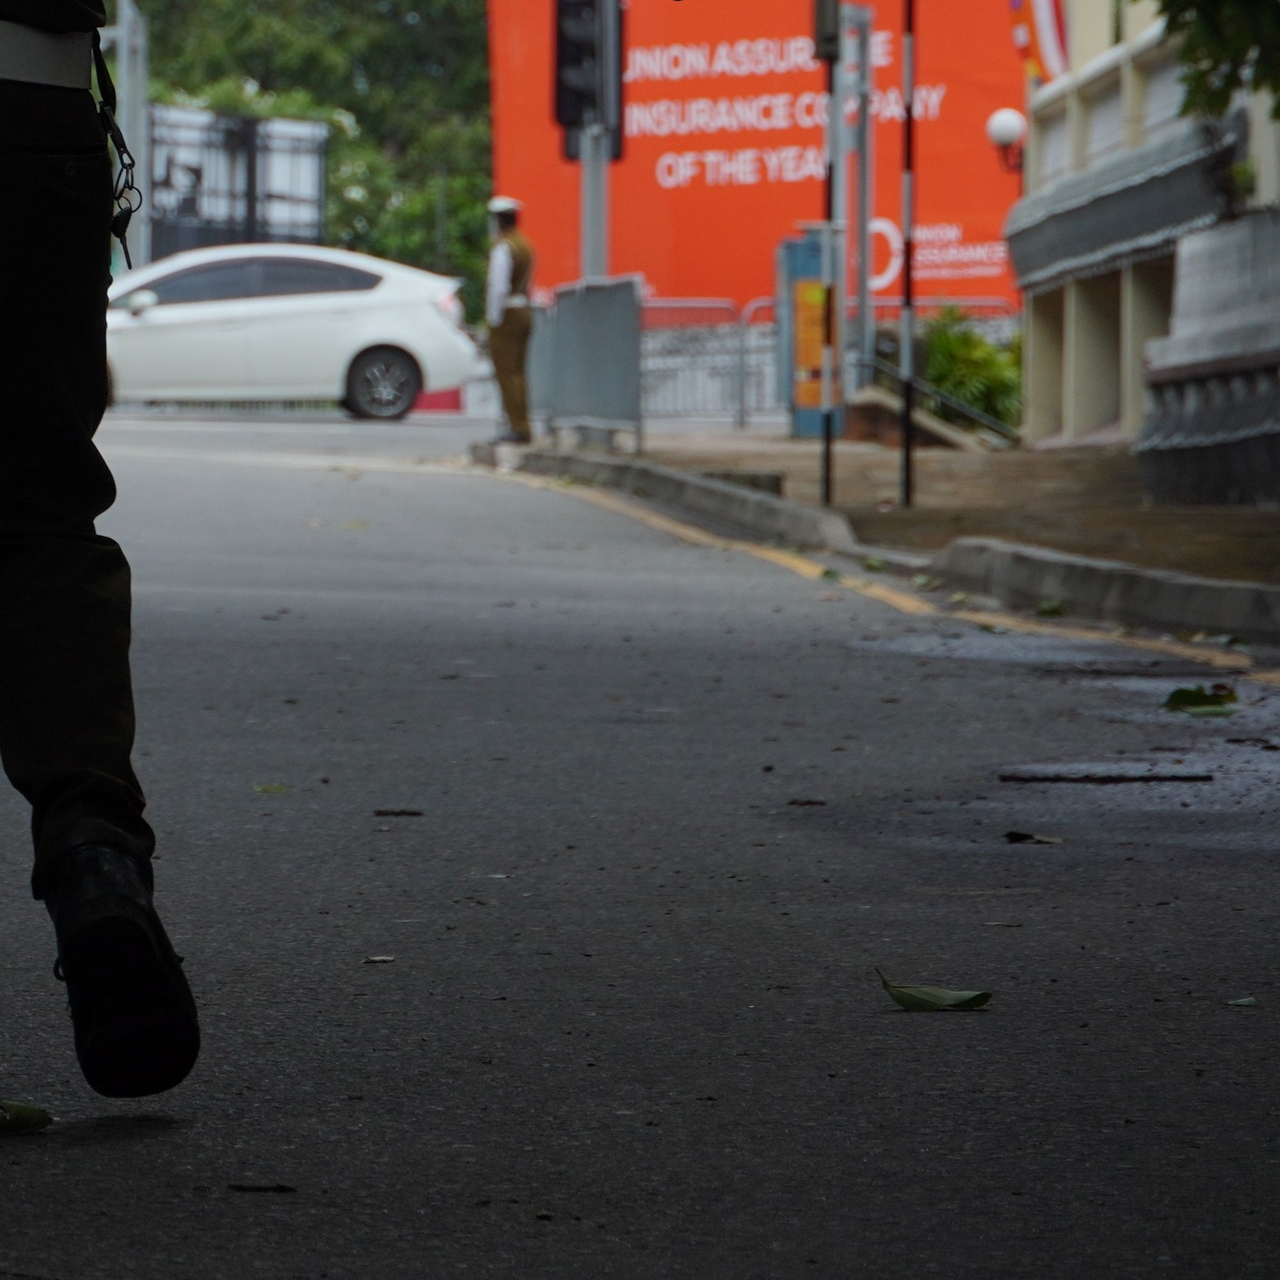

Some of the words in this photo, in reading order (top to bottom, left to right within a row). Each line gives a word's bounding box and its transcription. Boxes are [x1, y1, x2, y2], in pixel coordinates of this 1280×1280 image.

[624, 92, 791, 138] INSURANCE
[655, 151, 700, 189] OF
[704, 149, 761, 186] THE
[762, 145, 828, 183] YEA
